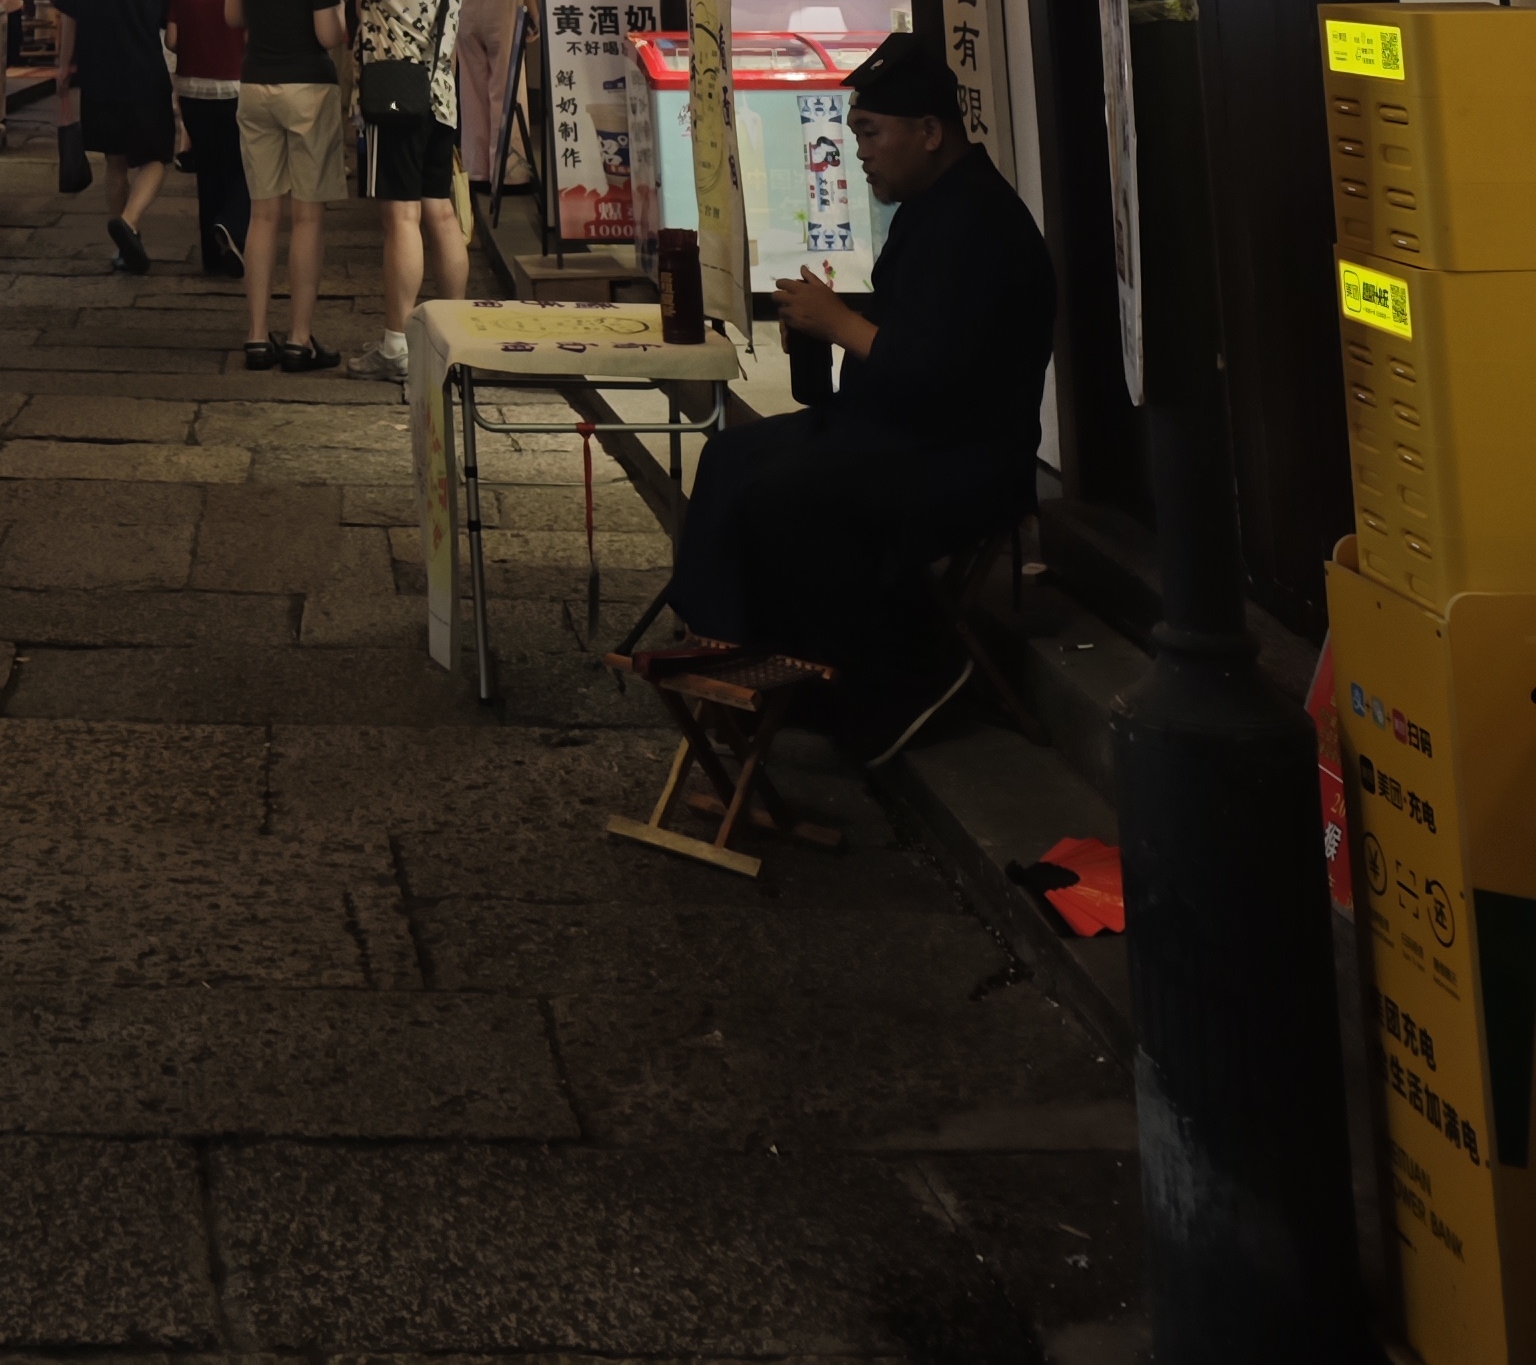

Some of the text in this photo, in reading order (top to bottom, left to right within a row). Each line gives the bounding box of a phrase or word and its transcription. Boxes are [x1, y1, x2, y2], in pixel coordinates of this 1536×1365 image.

[552, 5, 657, 36] 黄酒奶
[566, 41, 627, 57] 不好喝
[1378, 1046, 1481, 1168] 生活加满电
[1430, 1210, 1465, 1265] BANK
